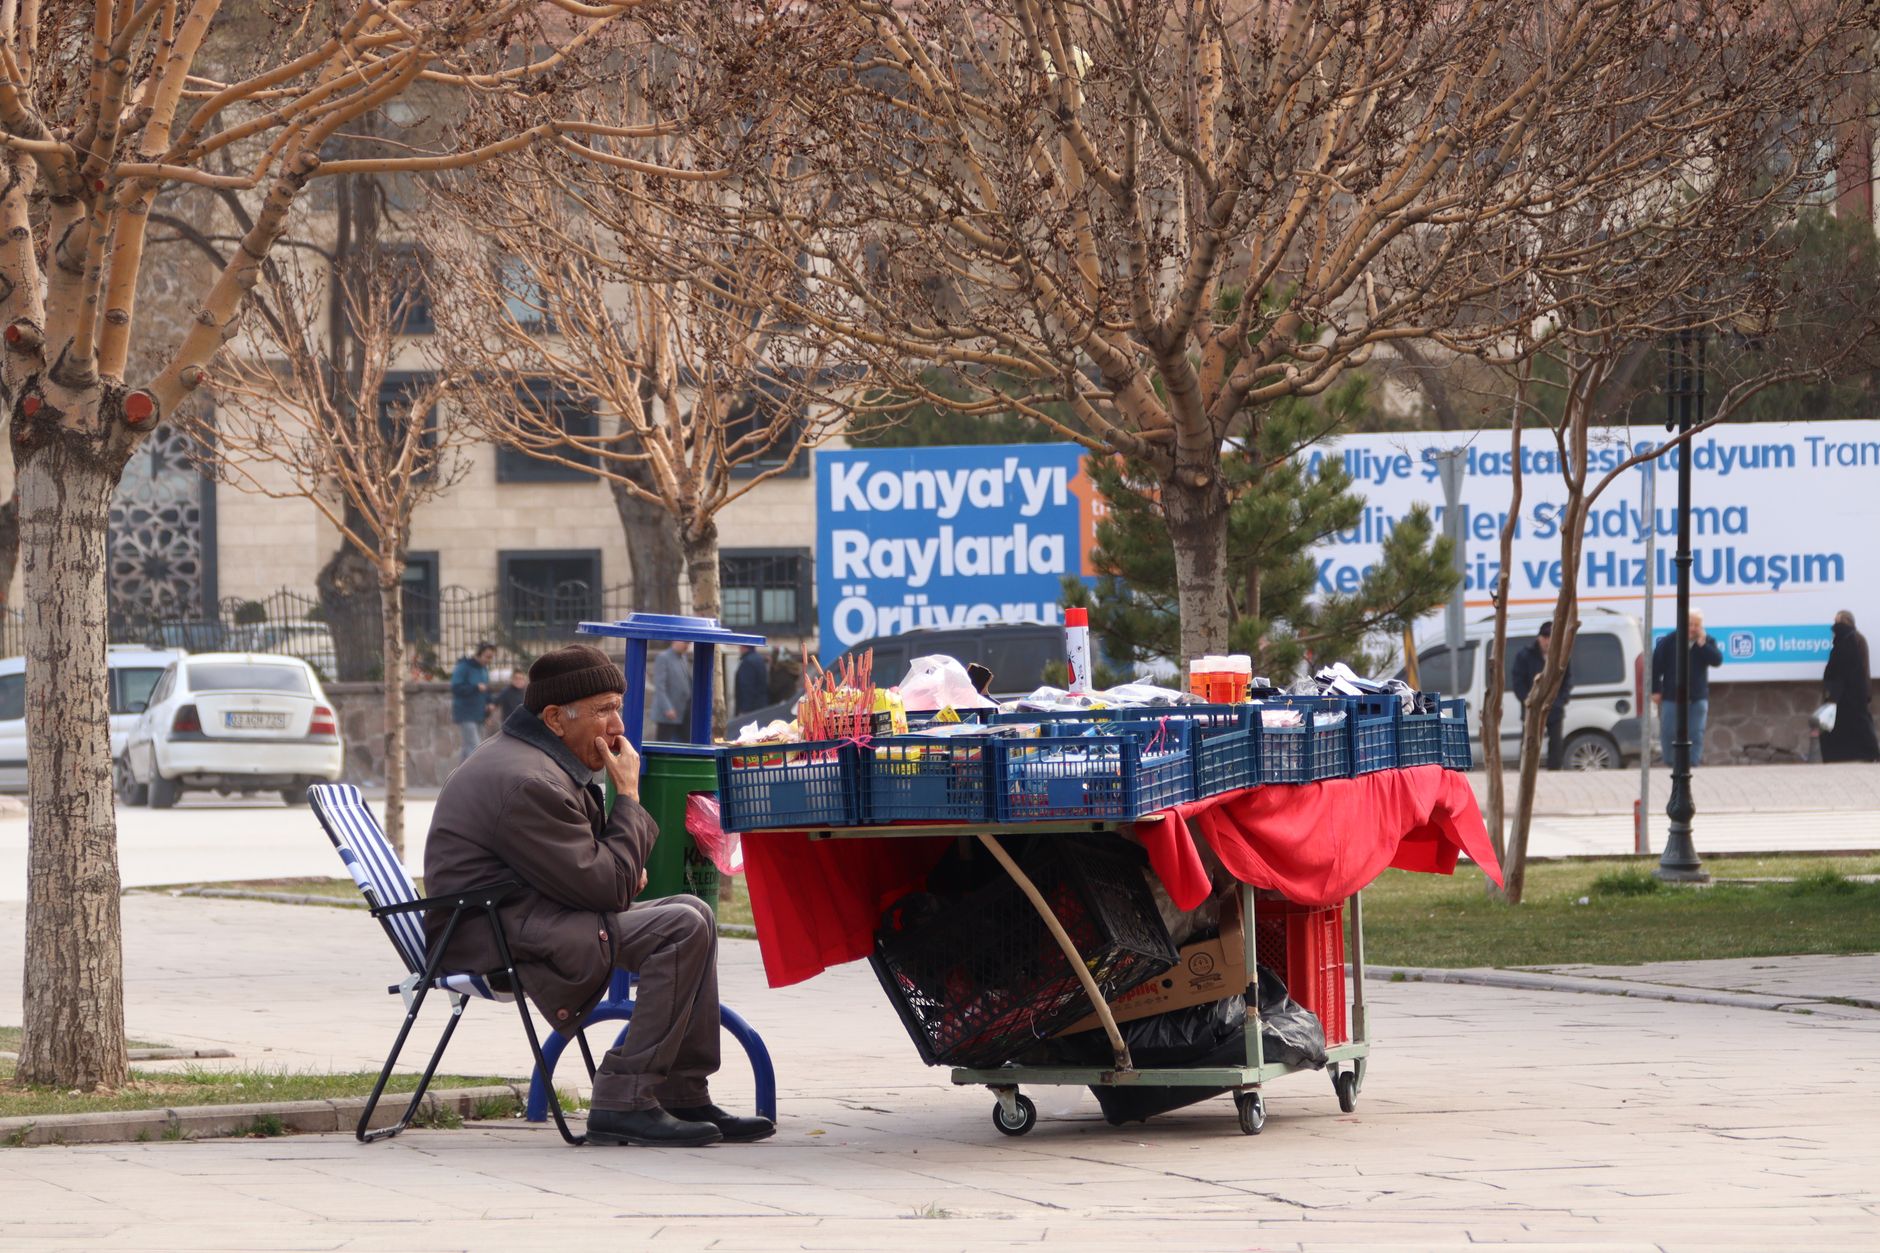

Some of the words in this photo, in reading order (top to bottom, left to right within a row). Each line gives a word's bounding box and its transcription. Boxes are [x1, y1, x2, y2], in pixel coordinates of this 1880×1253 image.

[830, 457, 1067, 519] Konya'yı
[831, 523, 1065, 587] Raylarla
[1692, 547, 1845, 591] Ulaşım
[1759, 637, 1776, 651] 10
[1779, 635, 1833, 653] İstasyo
